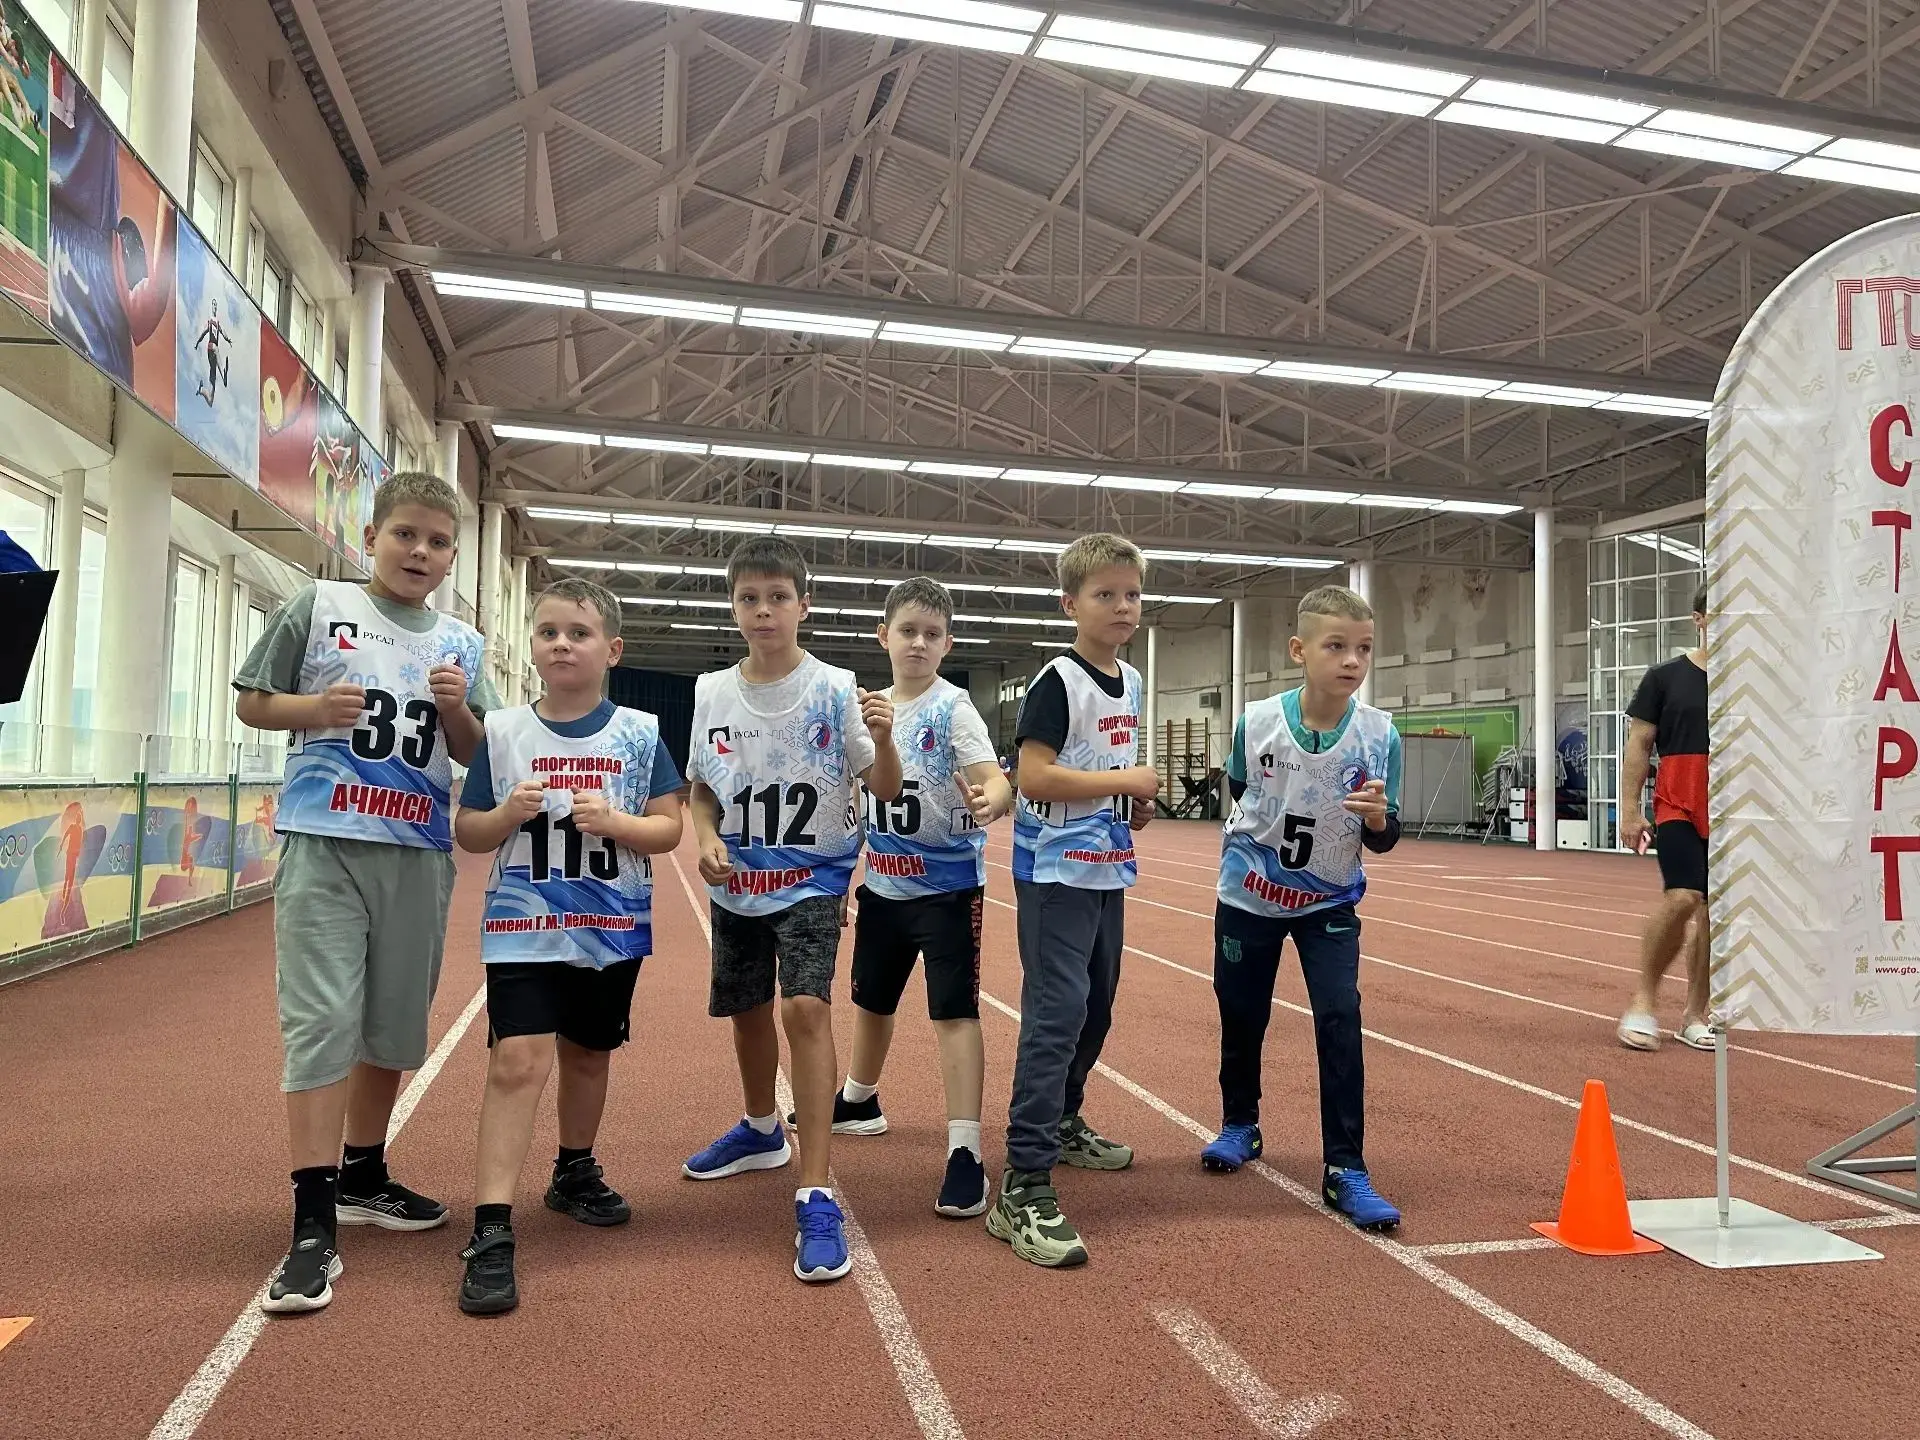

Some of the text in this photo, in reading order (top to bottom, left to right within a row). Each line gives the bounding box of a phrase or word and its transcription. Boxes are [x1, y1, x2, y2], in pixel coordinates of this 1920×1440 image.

[362, 631, 395, 646] РУСАЛ
[1870, 404, 1920, 921] СТАРТ
[351, 688, 439, 769] 33
[532, 756, 622, 775] СПОРТИВНАЯ
[549, 774, 603, 790] ШКОЛА
[330, 783, 433, 824] АЧИНСК
[733, 783, 817, 848] 112
[1280, 813, 1316, 870] 5
[486, 918, 532, 933] имени
[536, 914, 561, 930] Г.М.
